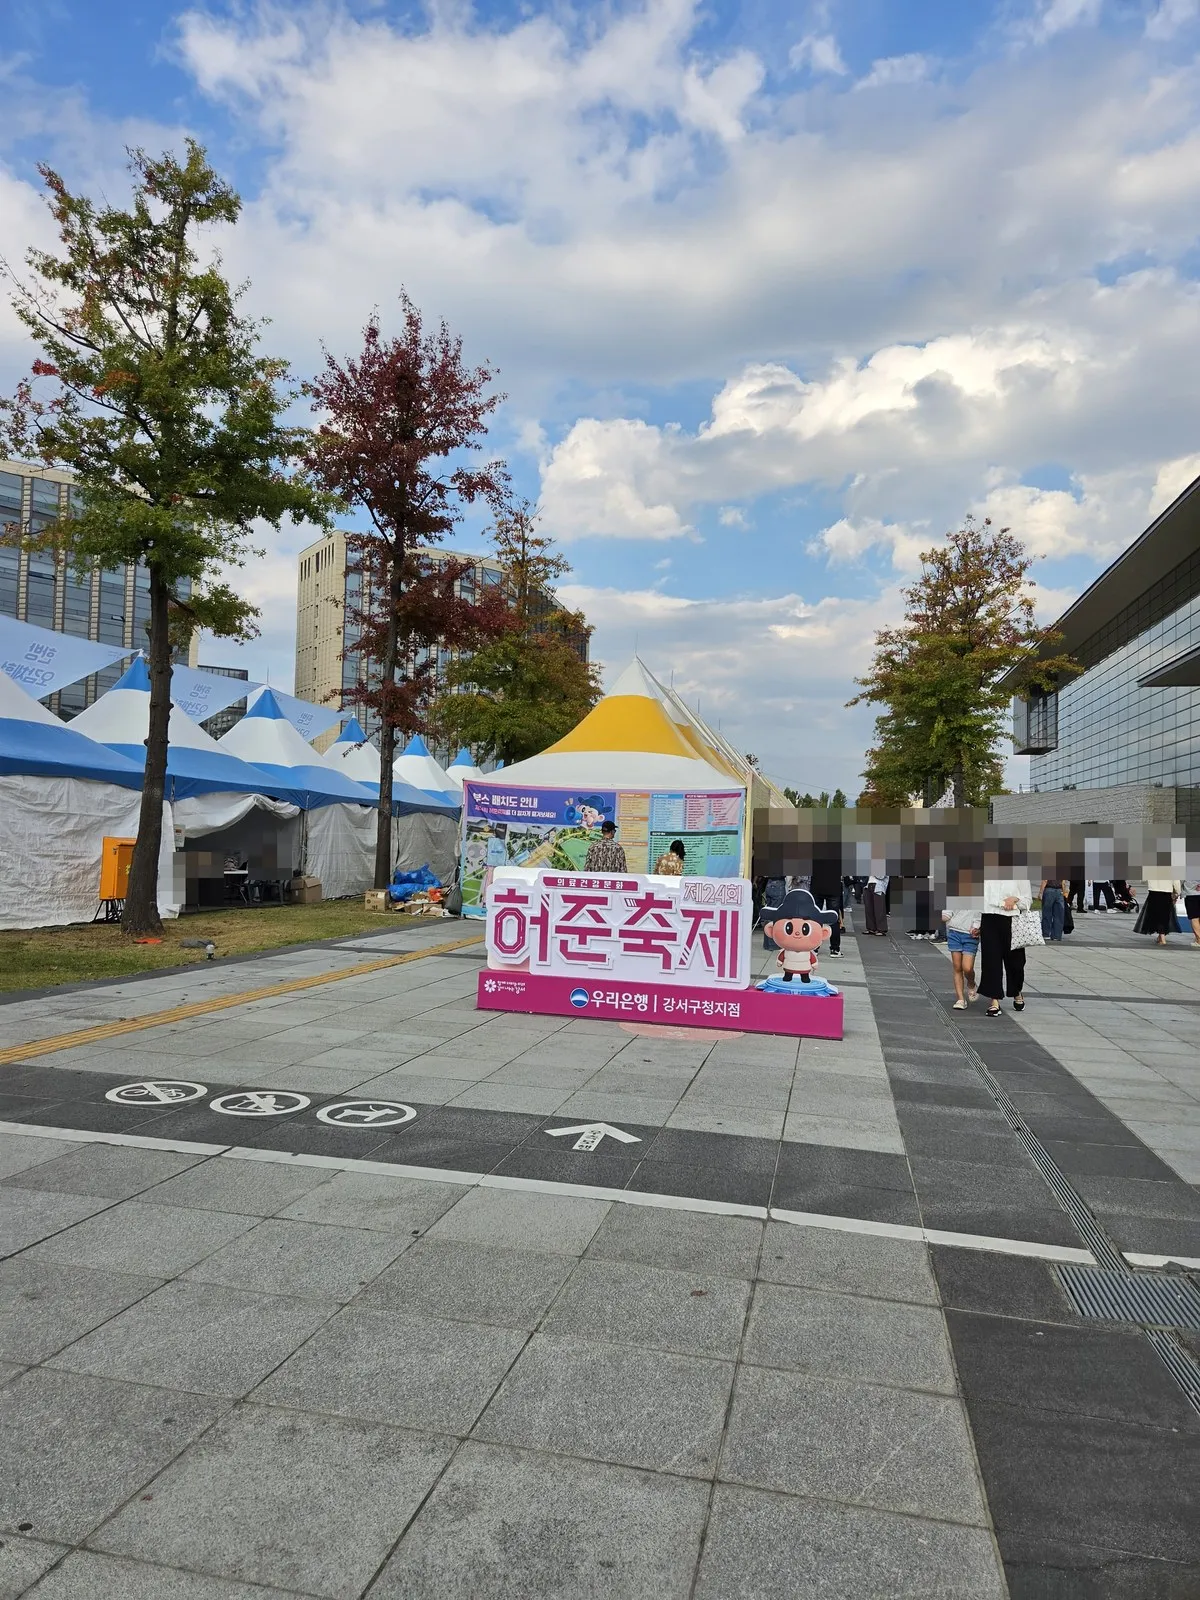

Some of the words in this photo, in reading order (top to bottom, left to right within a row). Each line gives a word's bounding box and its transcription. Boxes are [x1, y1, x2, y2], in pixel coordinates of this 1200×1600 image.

[473, 792, 489, 804] 부스
[491, 795, 517, 806] 배치도
[520, 797, 538, 808] 안내
[684, 882, 743, 905] 제24회
[494, 888, 740, 979] 허준축제
[590, 990, 649, 1012] 우리은행
[662, 998, 741, 1018] 강서구청지점
